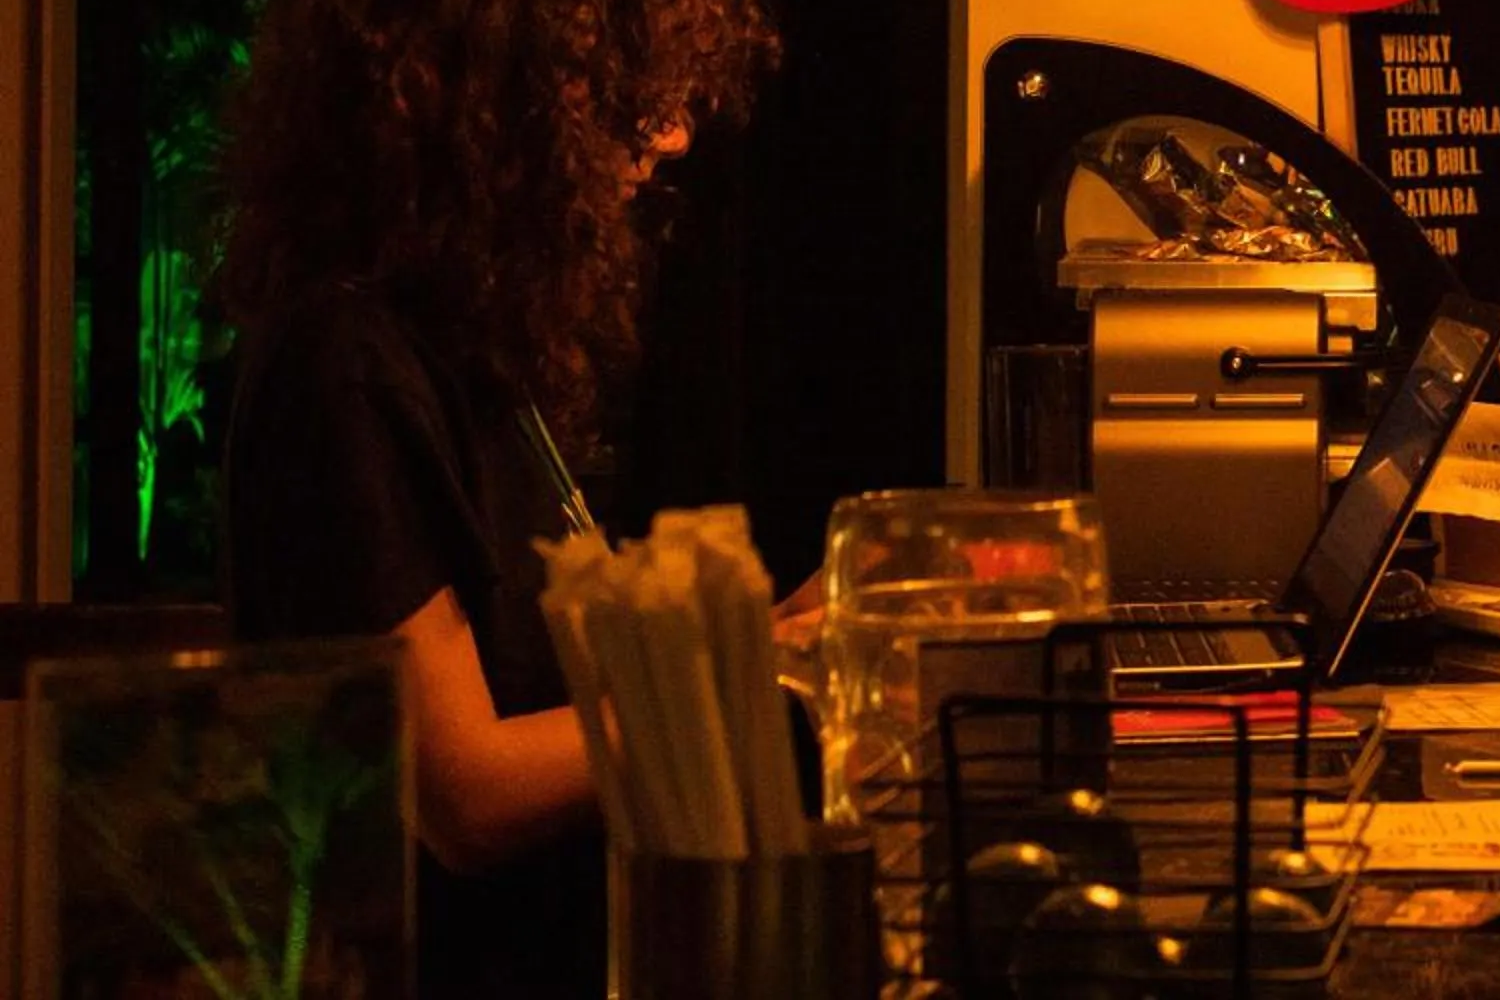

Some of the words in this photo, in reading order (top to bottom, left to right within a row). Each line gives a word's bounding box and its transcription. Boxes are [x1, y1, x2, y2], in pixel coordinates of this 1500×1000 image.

[1380, 34, 1452, 63] WHISKY
[1382, 66, 1462, 95] TEQUILA
[1387, 106, 1453, 137] FERNET
[1391, 148, 1429, 177] RED
[1436, 146, 1483, 176] BULL
